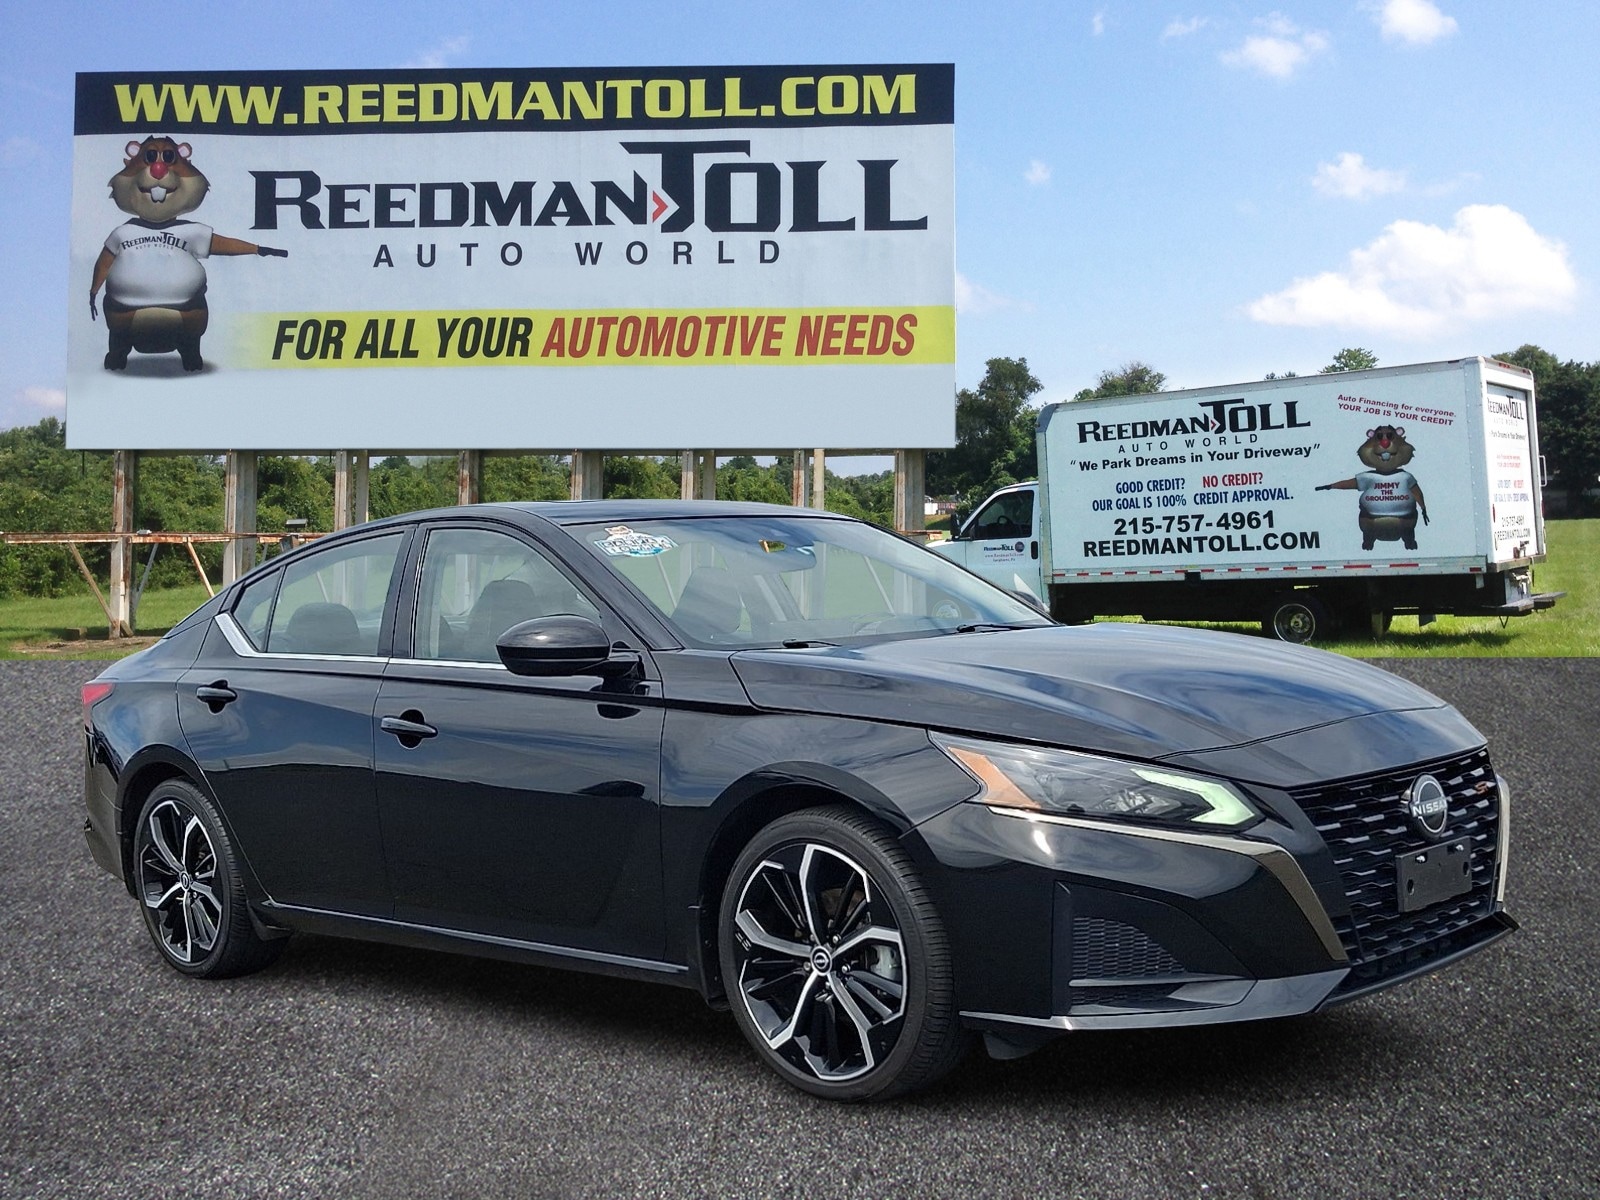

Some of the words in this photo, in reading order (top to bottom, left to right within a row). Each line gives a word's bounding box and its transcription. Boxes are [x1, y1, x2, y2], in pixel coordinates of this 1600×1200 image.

[114, 73, 917, 125] WWW.REEDMANTOLL.COM
[373, 242, 523, 268] AUTO
[575, 240, 781, 266] WORLD
[272, 319, 346, 361] FOR
[354, 318, 419, 360] ALL
[436, 317, 533, 359] YOUR
[541, 315, 786, 359] AUTOMOTIVE
[794, 313, 919, 357] NEEDS
[1337, 394, 1357, 403] Auto
[1359, 397, 1399, 410] Financing
[1401, 403, 1413, 411] for
[1415, 406, 1457, 418] everyone.
[1338, 403, 1362, 412] YOUR
[1363, 407, 1381, 415] JOB
[1383, 409, 1392, 417] IS
[1394, 411, 1419, 421] YOUR
[1420, 415, 1454, 426] CREDIT
[1118, 441, 1168, 454] AUTO
[1185, 433, 1258, 449] WORLD
[1102, 457, 1132, 470] Park
[1135, 455, 1187, 467] Dreams
[1190, 452, 1203, 463] in
[1207, 450, 1240, 462] Your
[1115, 481, 1144, 494] GOOD
[1146, 478, 1186, 493] CREDIT?
[1202, 475, 1219, 488] NO
[1221, 472, 1263, 487] CREDIT?
[1374, 481, 1400, 490] JIMMY
[1092, 499, 1113, 512] OUR
[1115, 497, 1141, 510] GOAL
[1143, 496, 1153, 509] IS
[1156, 493, 1187, 508] 100%
[1193, 491, 1229, 506] CREDIT
[1231, 487, 1294, 503] APPROVAL.
[1113, 510, 1275, 536] 215-757-4961
[1083, 531, 1320, 557] REEDMANTOLL.COM
